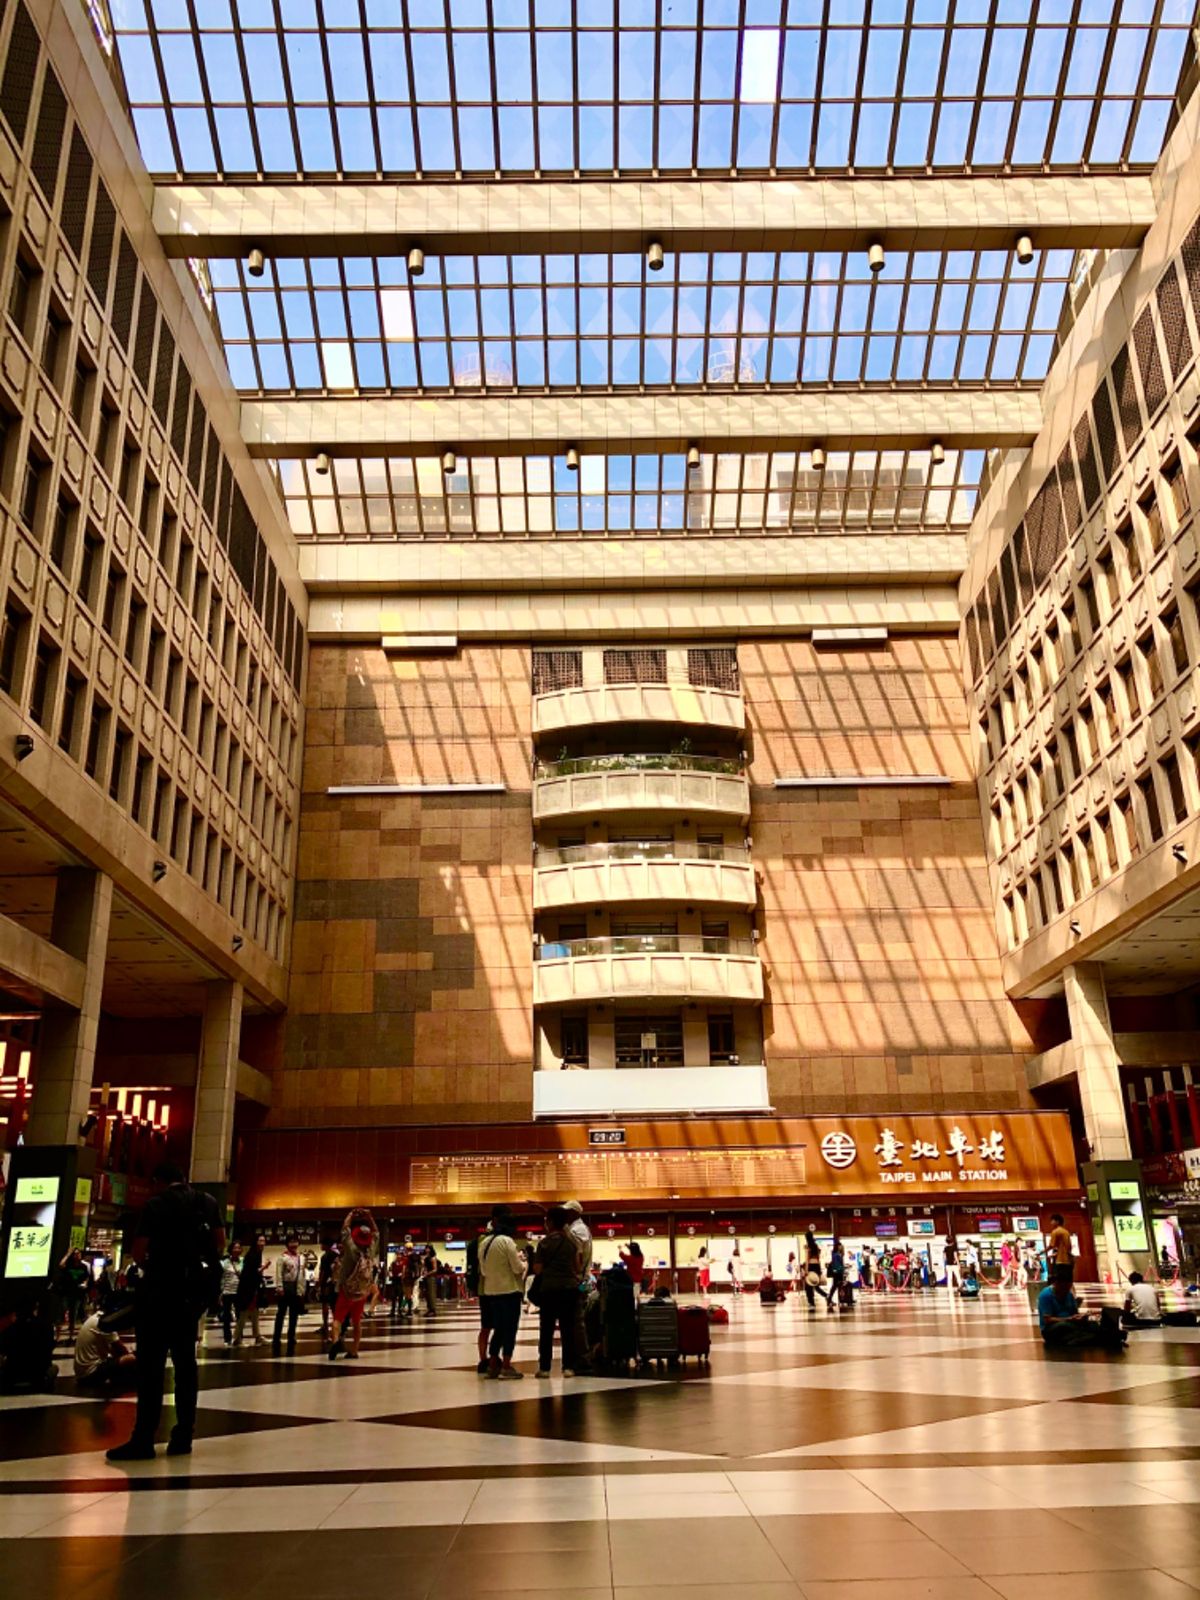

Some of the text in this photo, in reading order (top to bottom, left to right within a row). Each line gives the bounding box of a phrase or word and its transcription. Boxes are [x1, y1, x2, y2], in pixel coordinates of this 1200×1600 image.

[874, 1126, 1005, 1167] 臺北車站
[879, 1169, 1008, 1183] TAIPEI MAIN STATION
